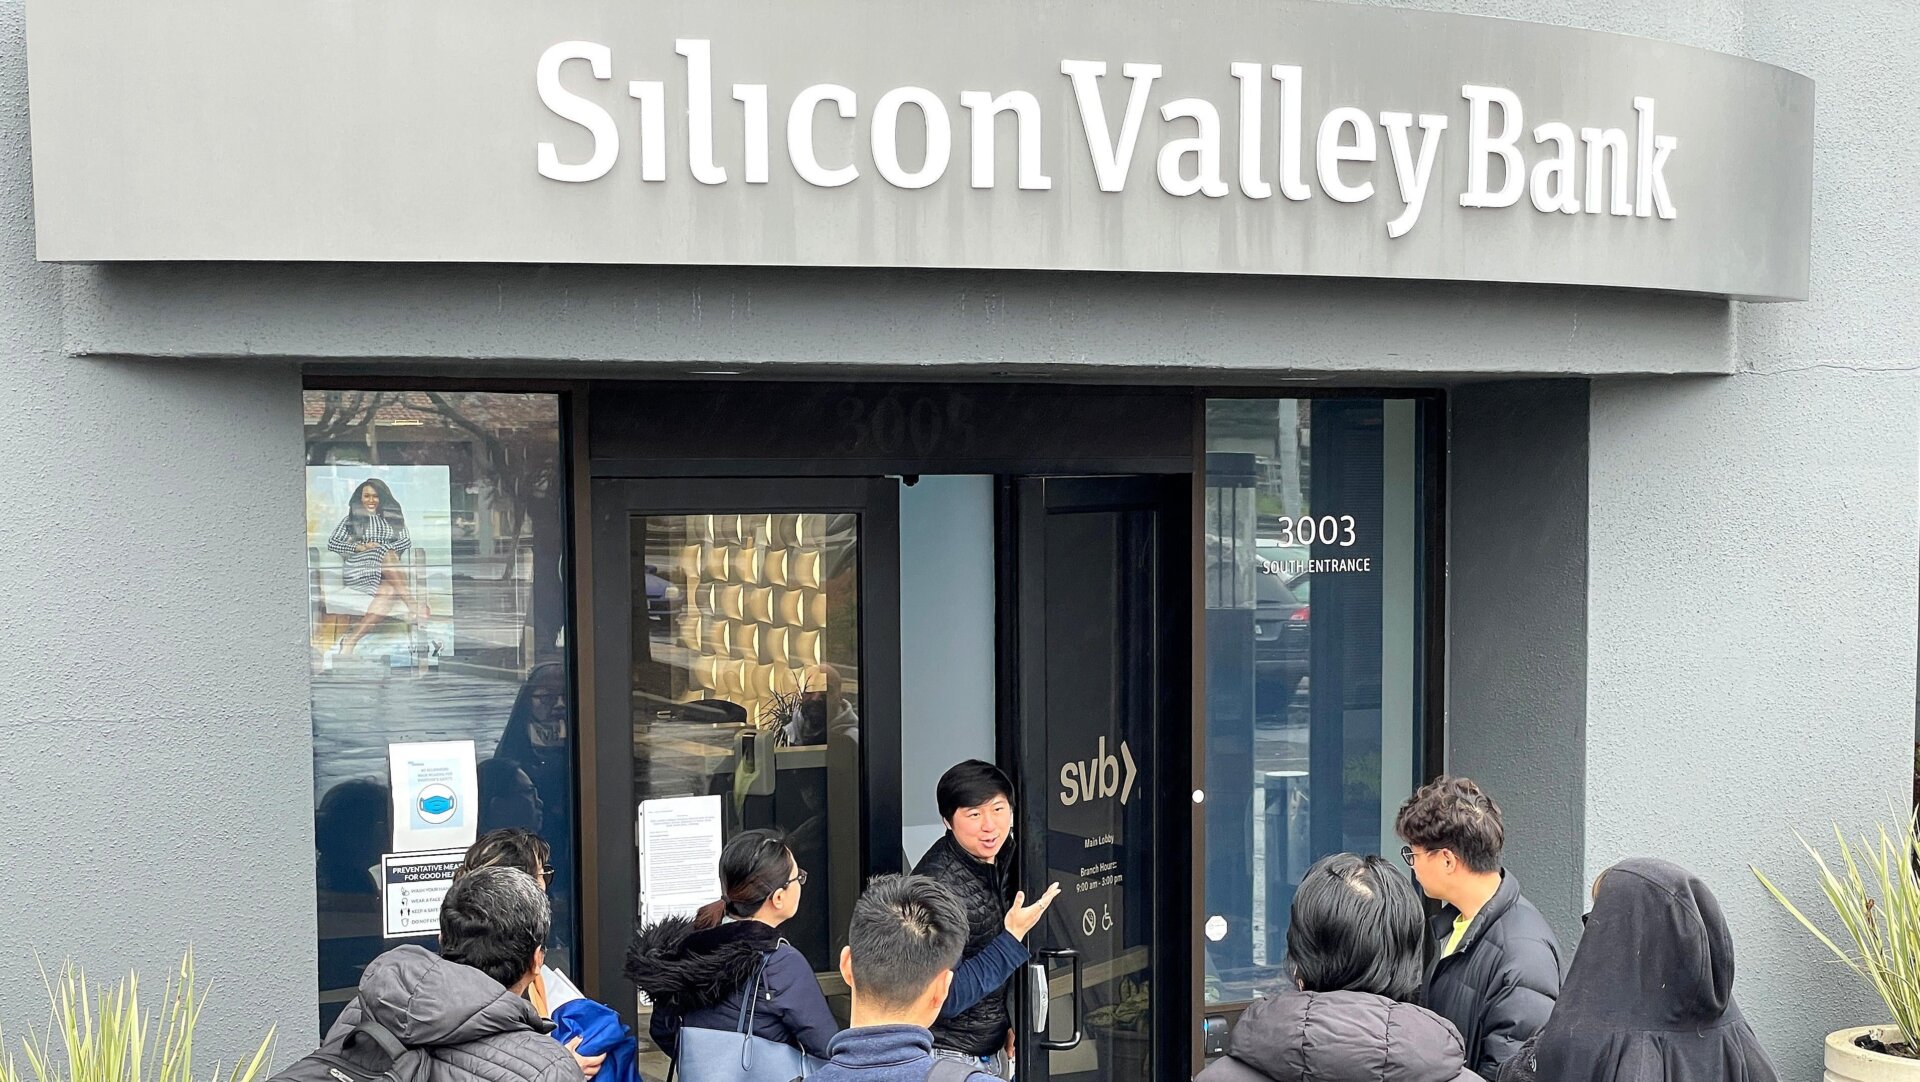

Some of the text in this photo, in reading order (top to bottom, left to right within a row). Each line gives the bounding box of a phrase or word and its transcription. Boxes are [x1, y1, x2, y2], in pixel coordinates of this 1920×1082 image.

[536, 38, 1678, 239] Silicon Valley Bank
[1278, 515, 1356, 547] 3003
[1262, 558, 1371, 574] SOUTH ENTRANCE
[1060, 736, 1119, 805] svb
[1084, 834, 1114, 848] Main Lobby
[392, 865, 443, 874] PREVENTATIVE
[404, 873, 418, 881] FOR
[419, 872, 441, 880] GOOD
[1080, 864, 1099, 877] Branch
[1076, 881, 1088, 893] 9:00
[1089, 881, 1097, 890] am
[1101, 875, 1113, 887] 3:00
[1113, 874, 1122, 886] pm
